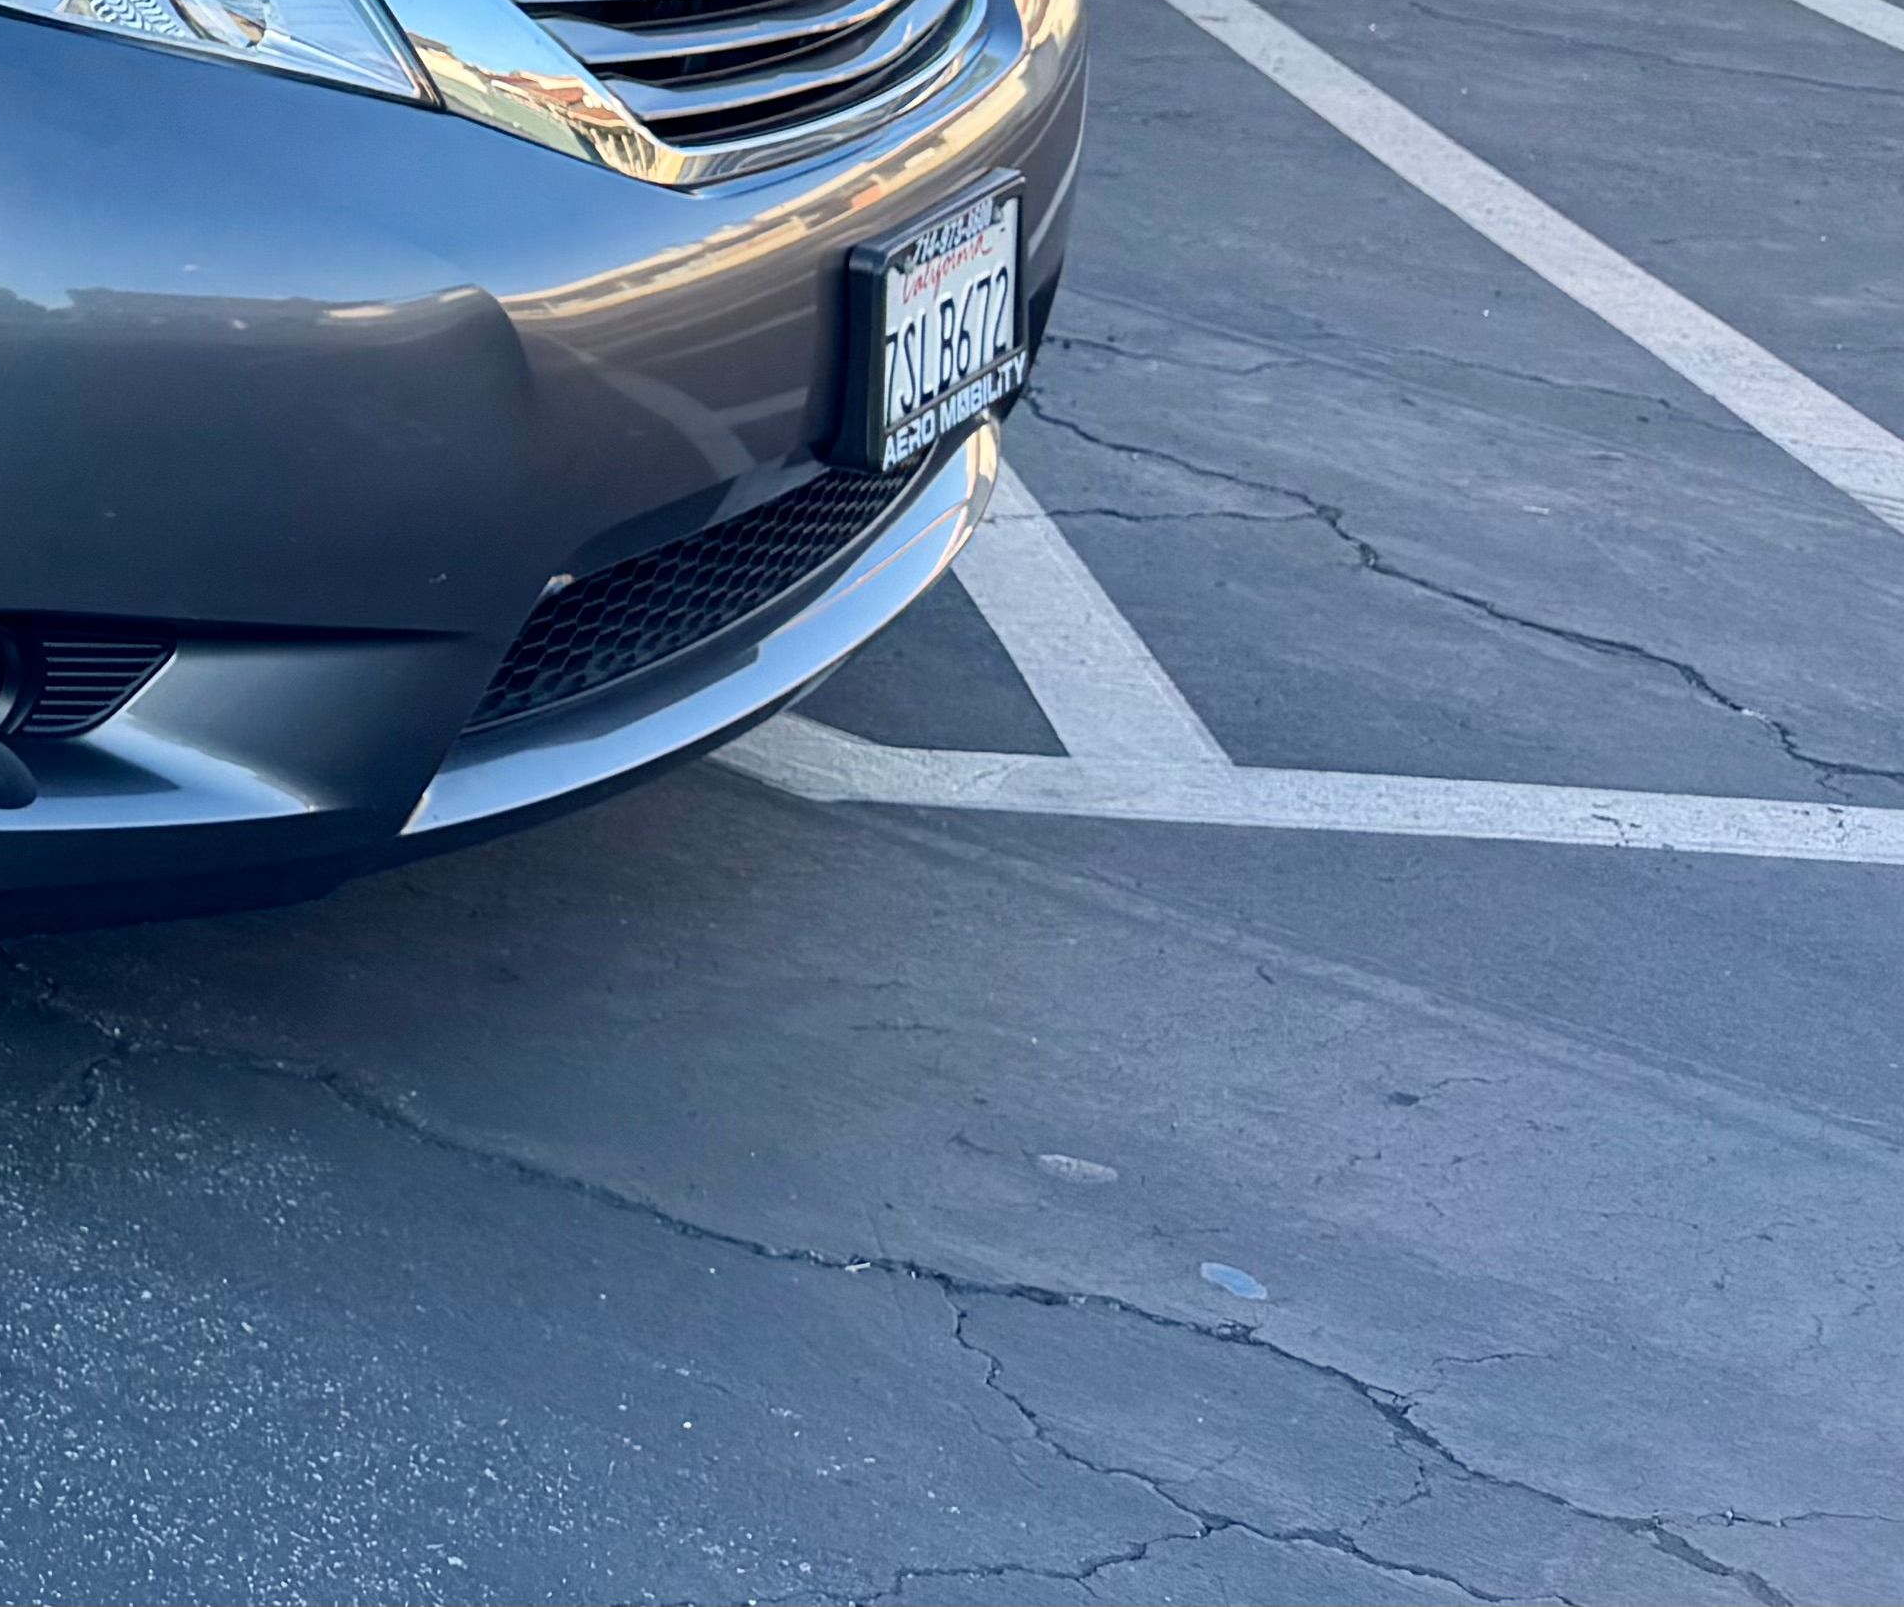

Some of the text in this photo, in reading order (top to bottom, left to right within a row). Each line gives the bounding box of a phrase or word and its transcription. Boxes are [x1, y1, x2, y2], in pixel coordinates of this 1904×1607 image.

[882, 350, 1028, 473] AERO MOBILITY
[885, 265, 1008, 427] 7SLB672
